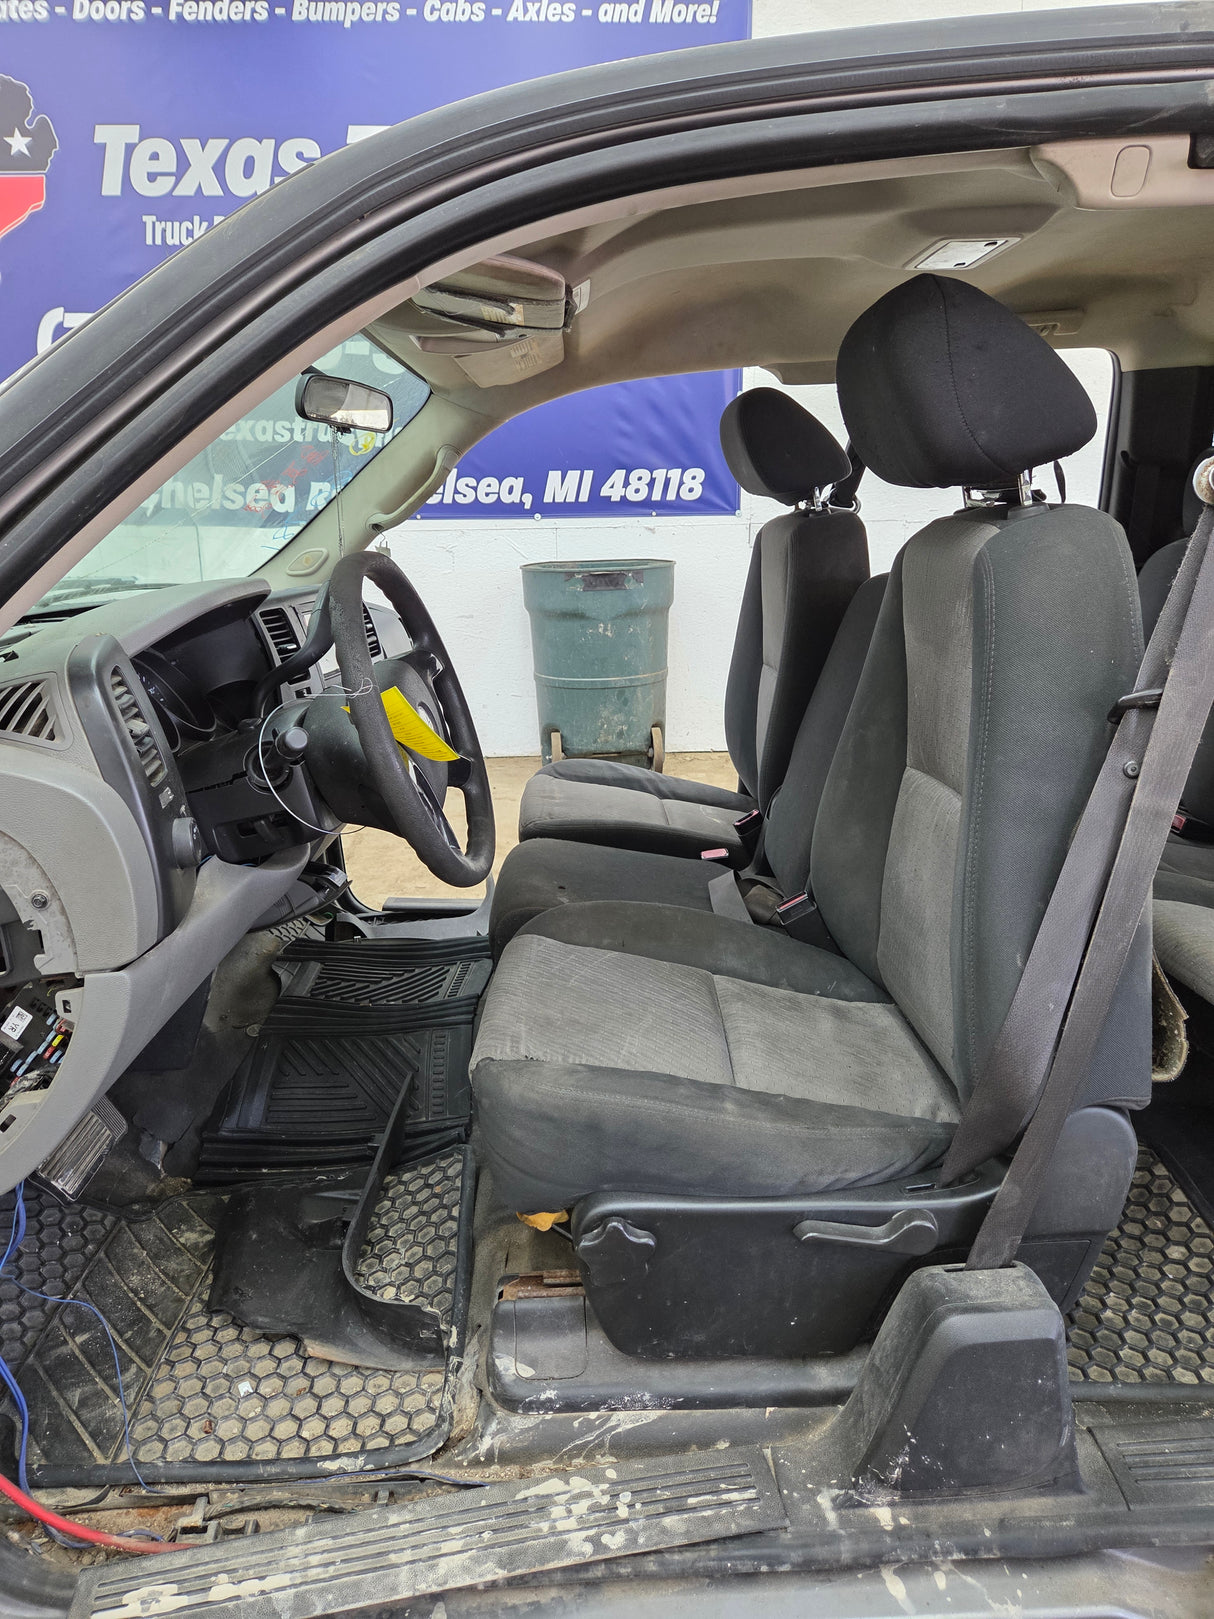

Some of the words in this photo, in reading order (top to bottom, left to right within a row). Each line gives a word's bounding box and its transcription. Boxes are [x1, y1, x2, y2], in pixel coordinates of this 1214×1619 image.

[73, 0, 146, 21] Doors
[168, 0, 268, 22] Fenders
[292, 0, 400, 28] Bumpers
[423, 0, 486, 22] Cabs
[506, 0, 576, 22] Axles
[598, 0, 645, 23] and
[649, 0, 720, 23] More!
[93, 124, 322, 198] Texas
[142, 215, 208, 246] Truck
[141, 473, 295, 516] helsea
[543, 469, 594, 503] MI
[600, 468, 705, 502] 48118
